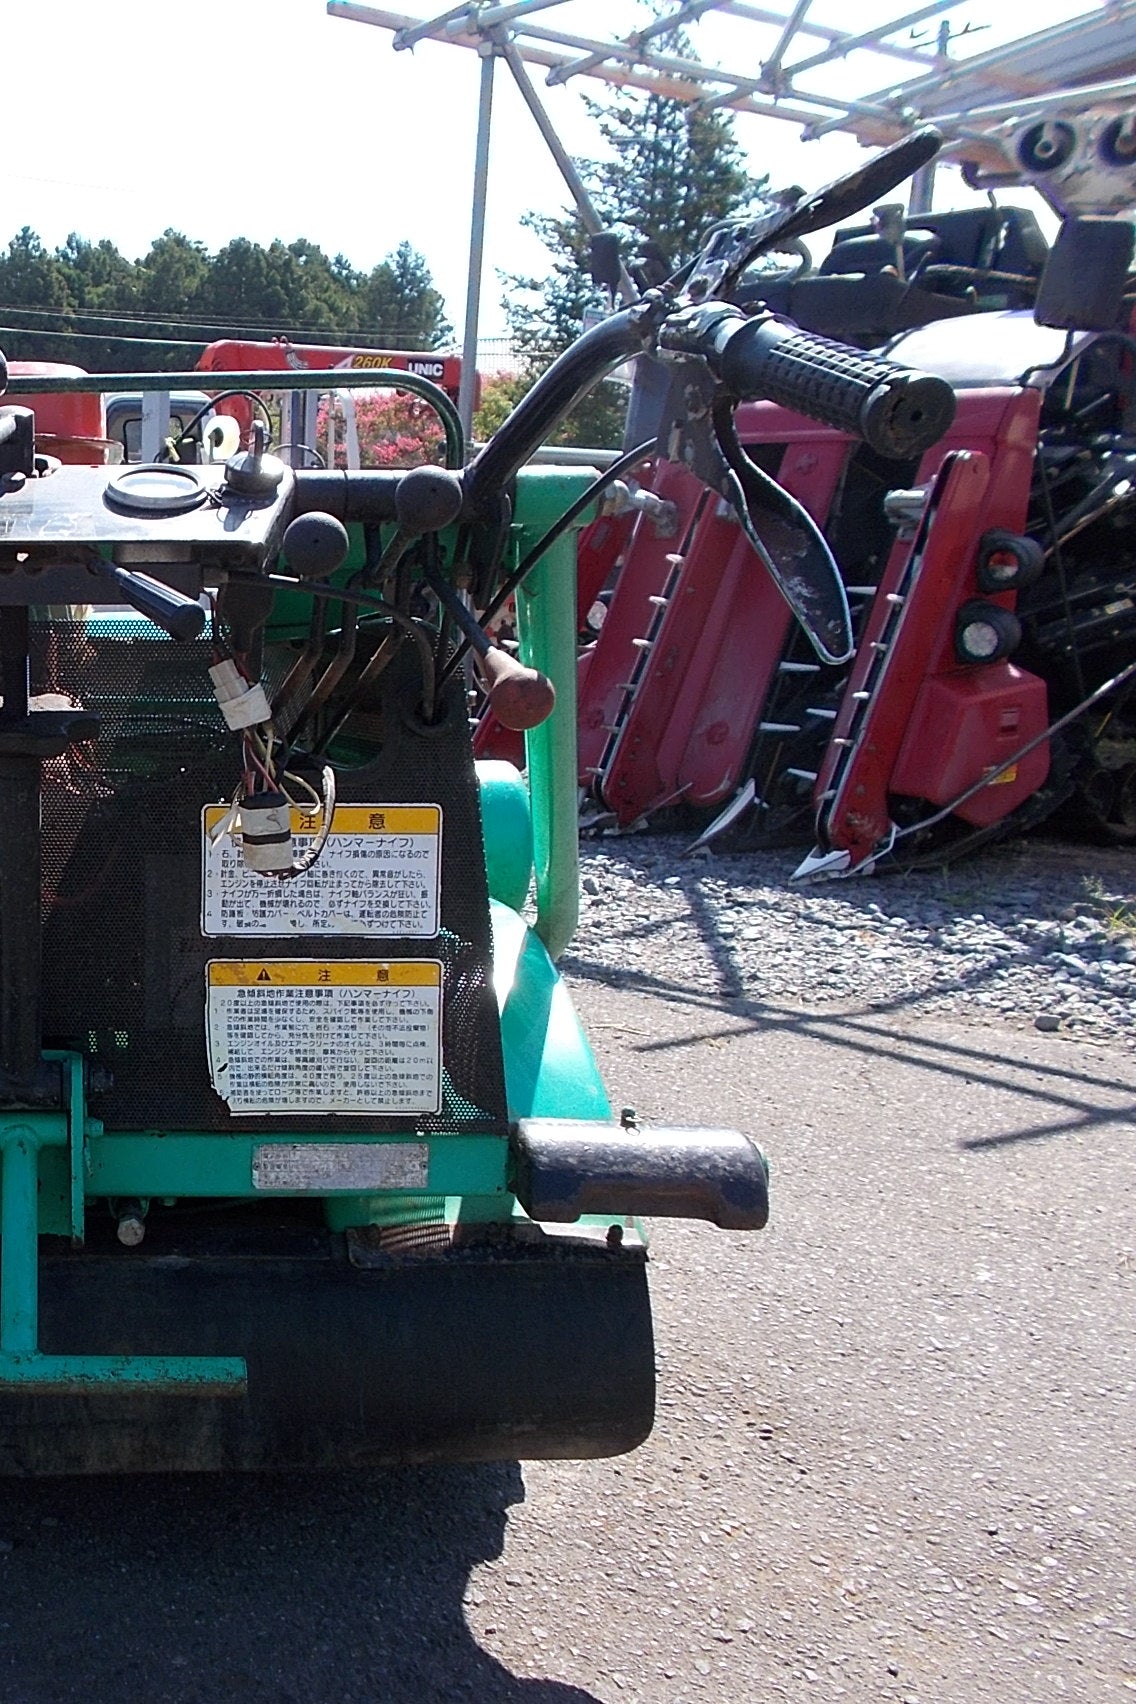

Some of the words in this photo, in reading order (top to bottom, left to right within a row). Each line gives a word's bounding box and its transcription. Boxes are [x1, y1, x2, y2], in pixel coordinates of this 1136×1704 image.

[354, 356, 392, 369] 260K
[408, 362, 443, 376] UNIC
[299, 813, 317, 830] 注
[368, 812, 386, 830] 意
[318, 969, 331, 982] 注
